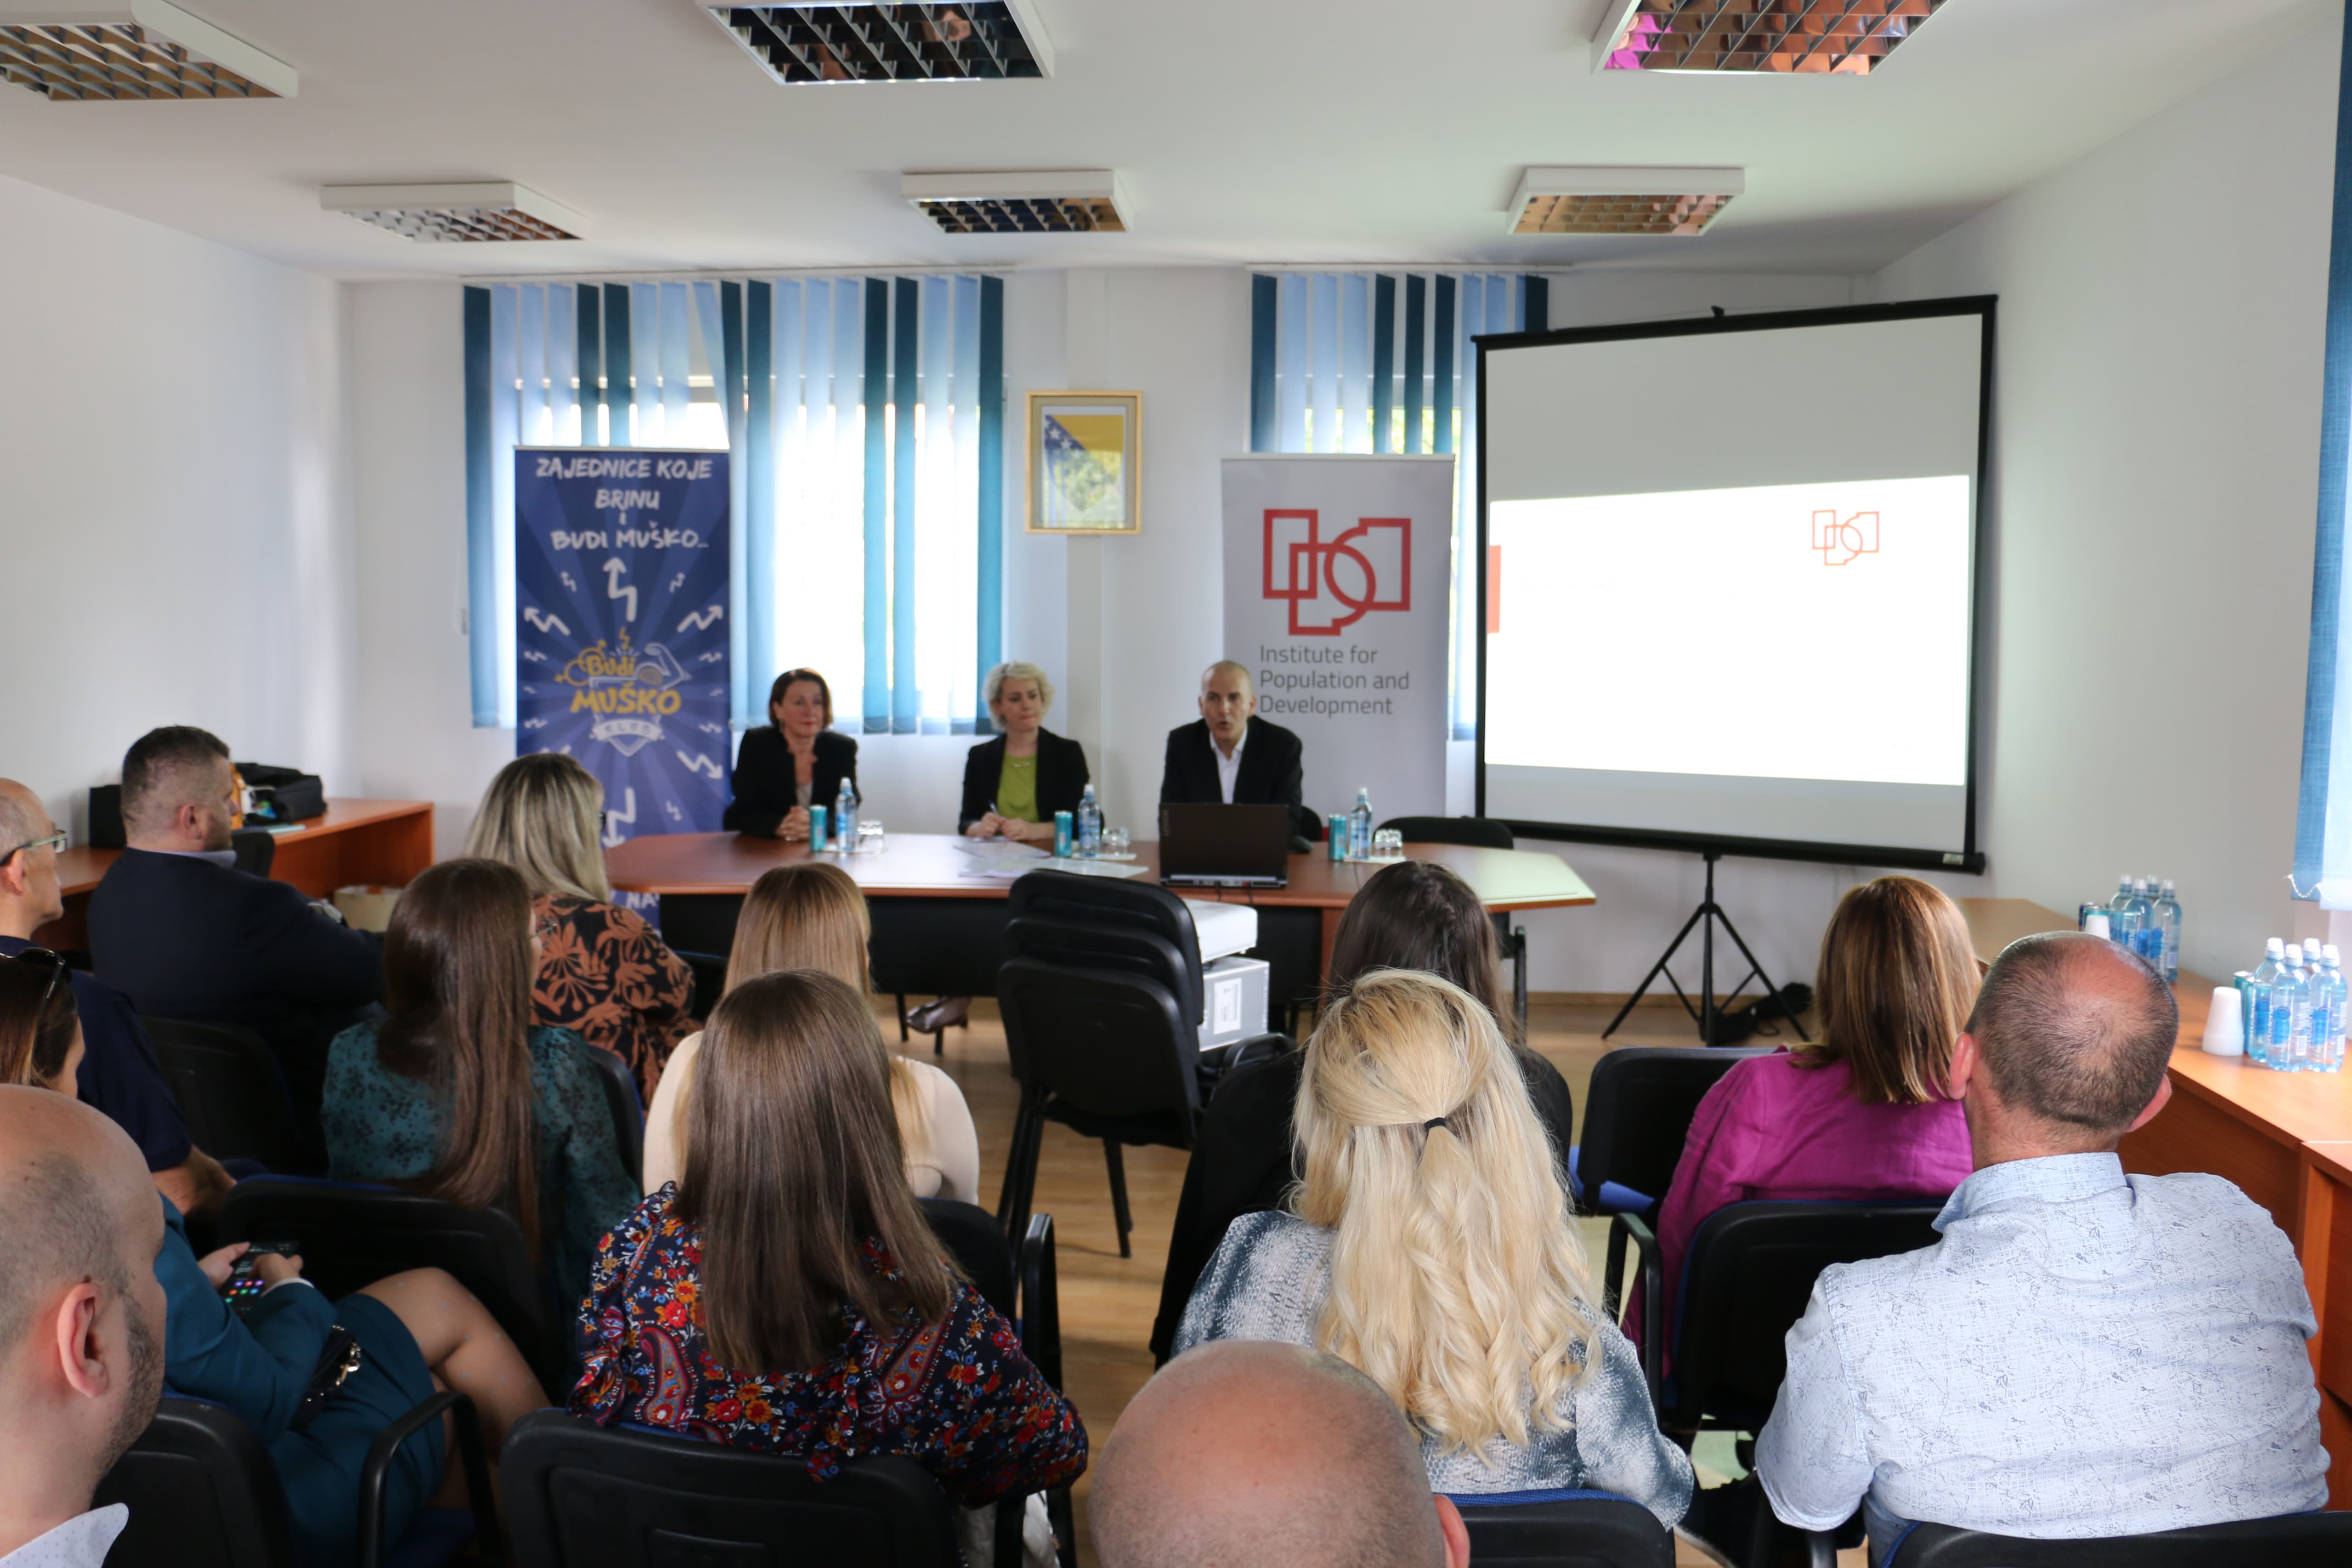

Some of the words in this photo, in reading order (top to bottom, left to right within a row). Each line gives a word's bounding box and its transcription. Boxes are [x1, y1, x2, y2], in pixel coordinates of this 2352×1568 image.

[536, 457, 651, 479] ZAJEDNICE
[656, 459, 712, 480] KOJE
[595, 488, 660, 510] BRINU
[551, 530, 608, 550] BUDI
[1260, 645, 1344, 663] Institute
[1350, 645, 1378, 663] for
[1260, 670, 1367, 692] Population
[1373, 671, 1409, 689] and
[570, 681, 681, 715] MUŠKO
[1260, 695, 1393, 718] Development
